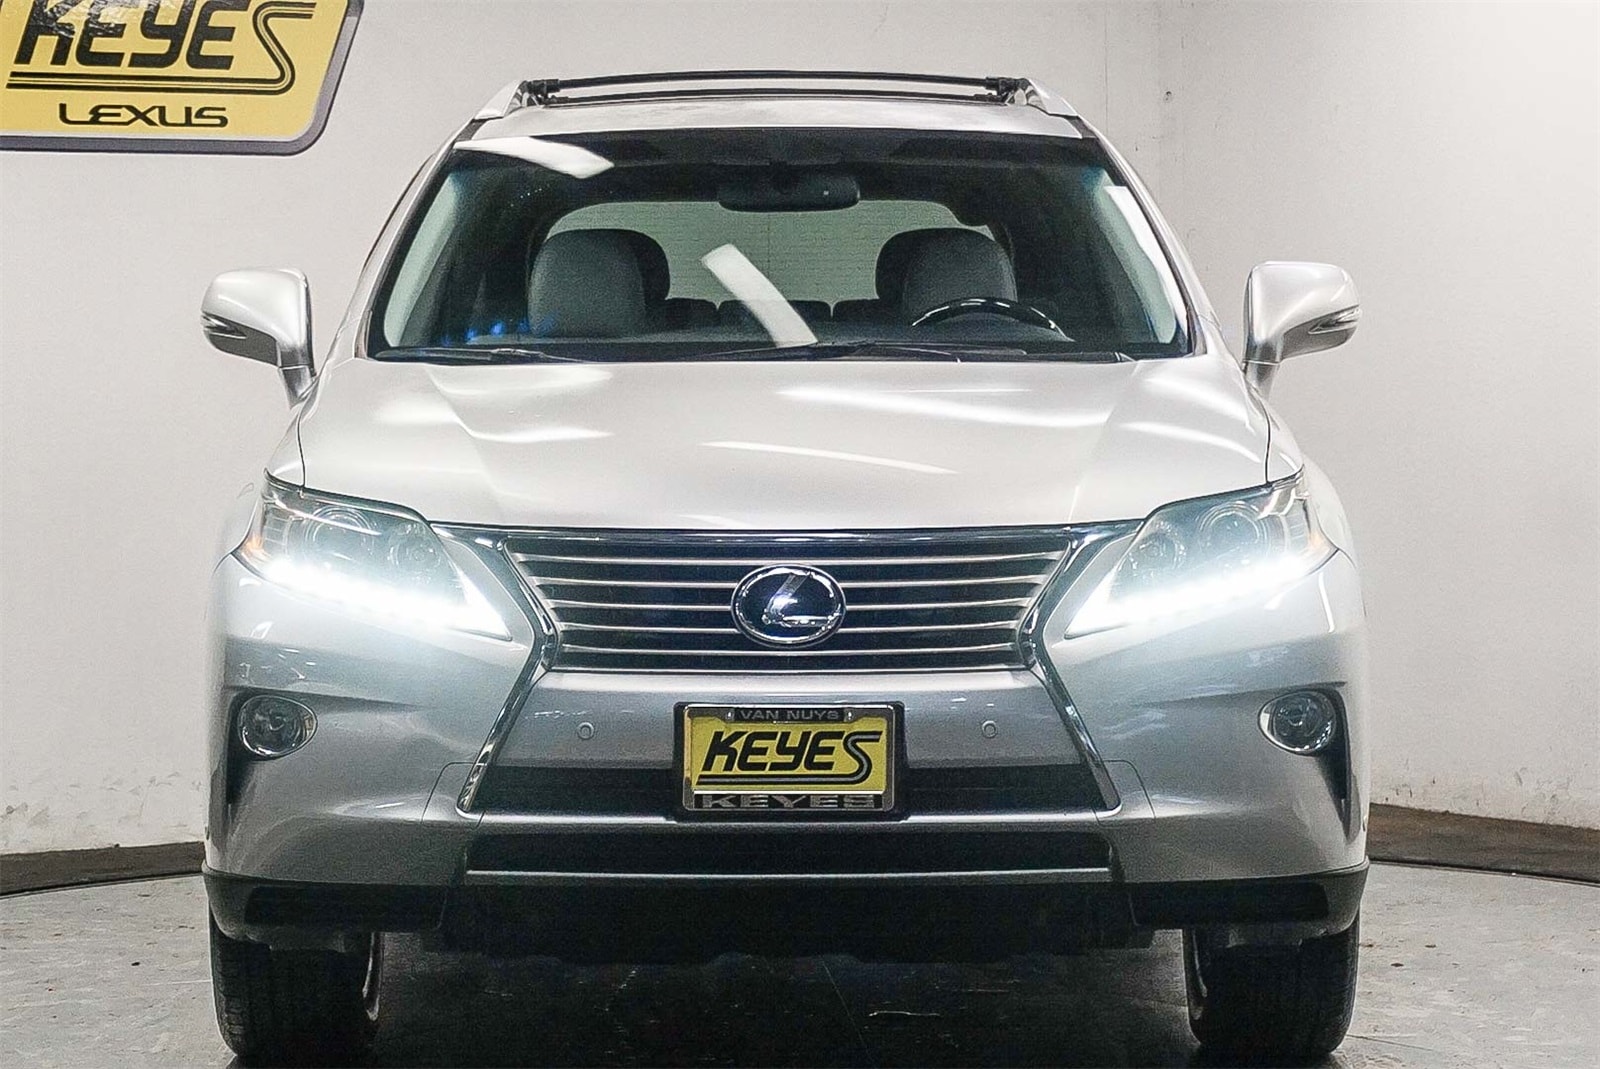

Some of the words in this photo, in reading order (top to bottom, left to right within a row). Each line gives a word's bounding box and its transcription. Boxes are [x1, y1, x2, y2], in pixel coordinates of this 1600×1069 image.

[6, 0, 317, 95] KEYES
[59, 103, 228, 127] LEXUS
[740, 710, 780, 720] VAN
[786, 710, 839, 720] NUYS
[696, 731, 883, 785] KEYES
[702, 795, 875, 808] KEYES
